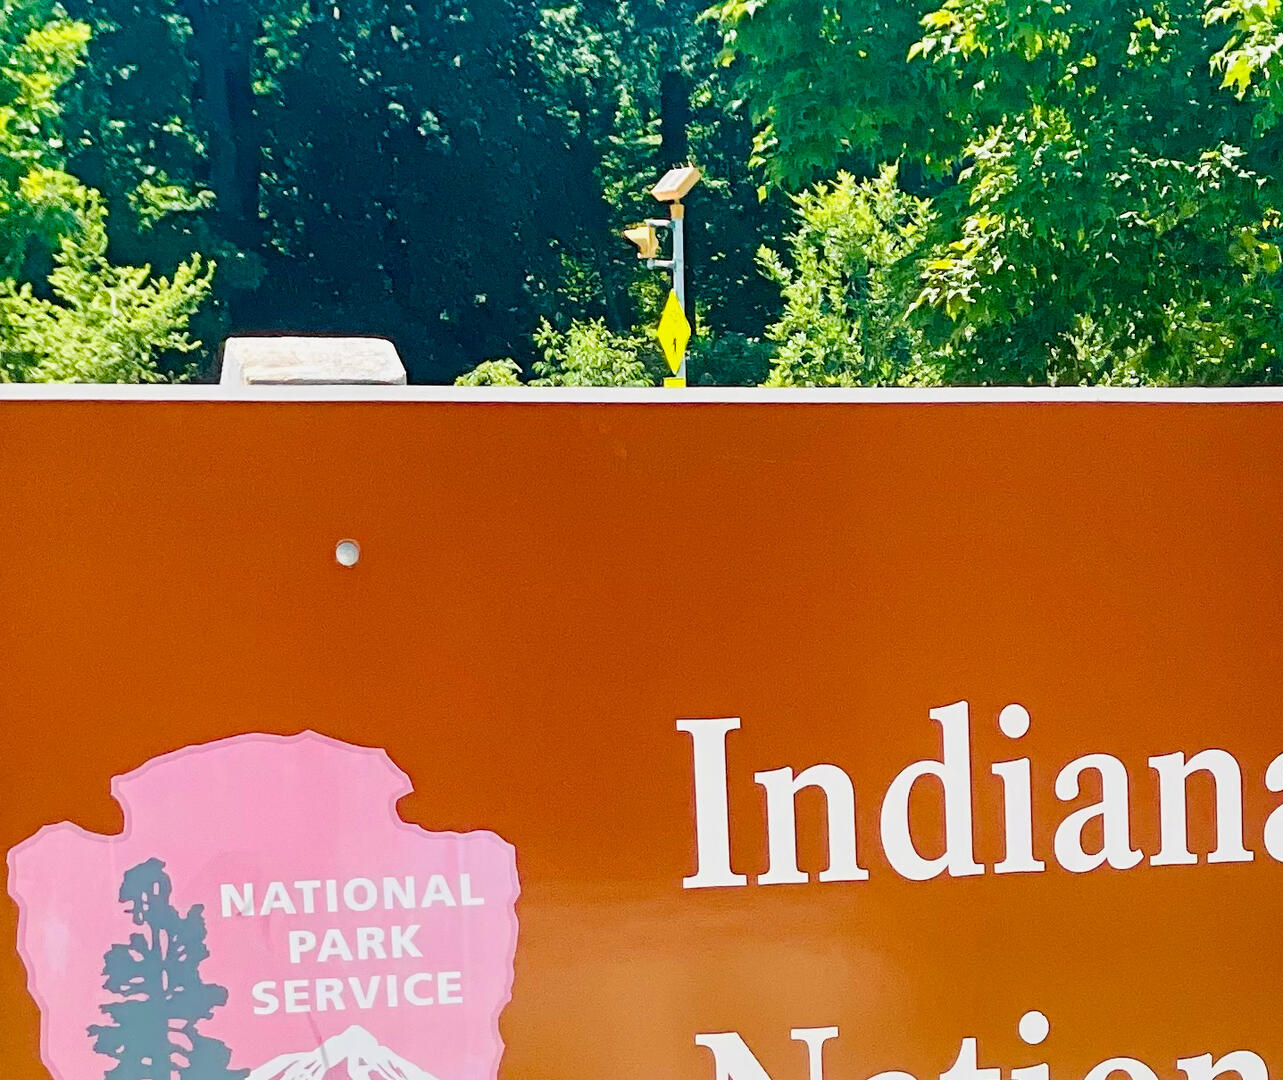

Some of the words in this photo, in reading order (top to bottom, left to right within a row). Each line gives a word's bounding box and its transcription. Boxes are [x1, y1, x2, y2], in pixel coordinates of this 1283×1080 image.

[219, 872, 485, 918] NATIONAL
[288, 924, 423, 964] PARK
[251, 970, 464, 1015] SERVICE
